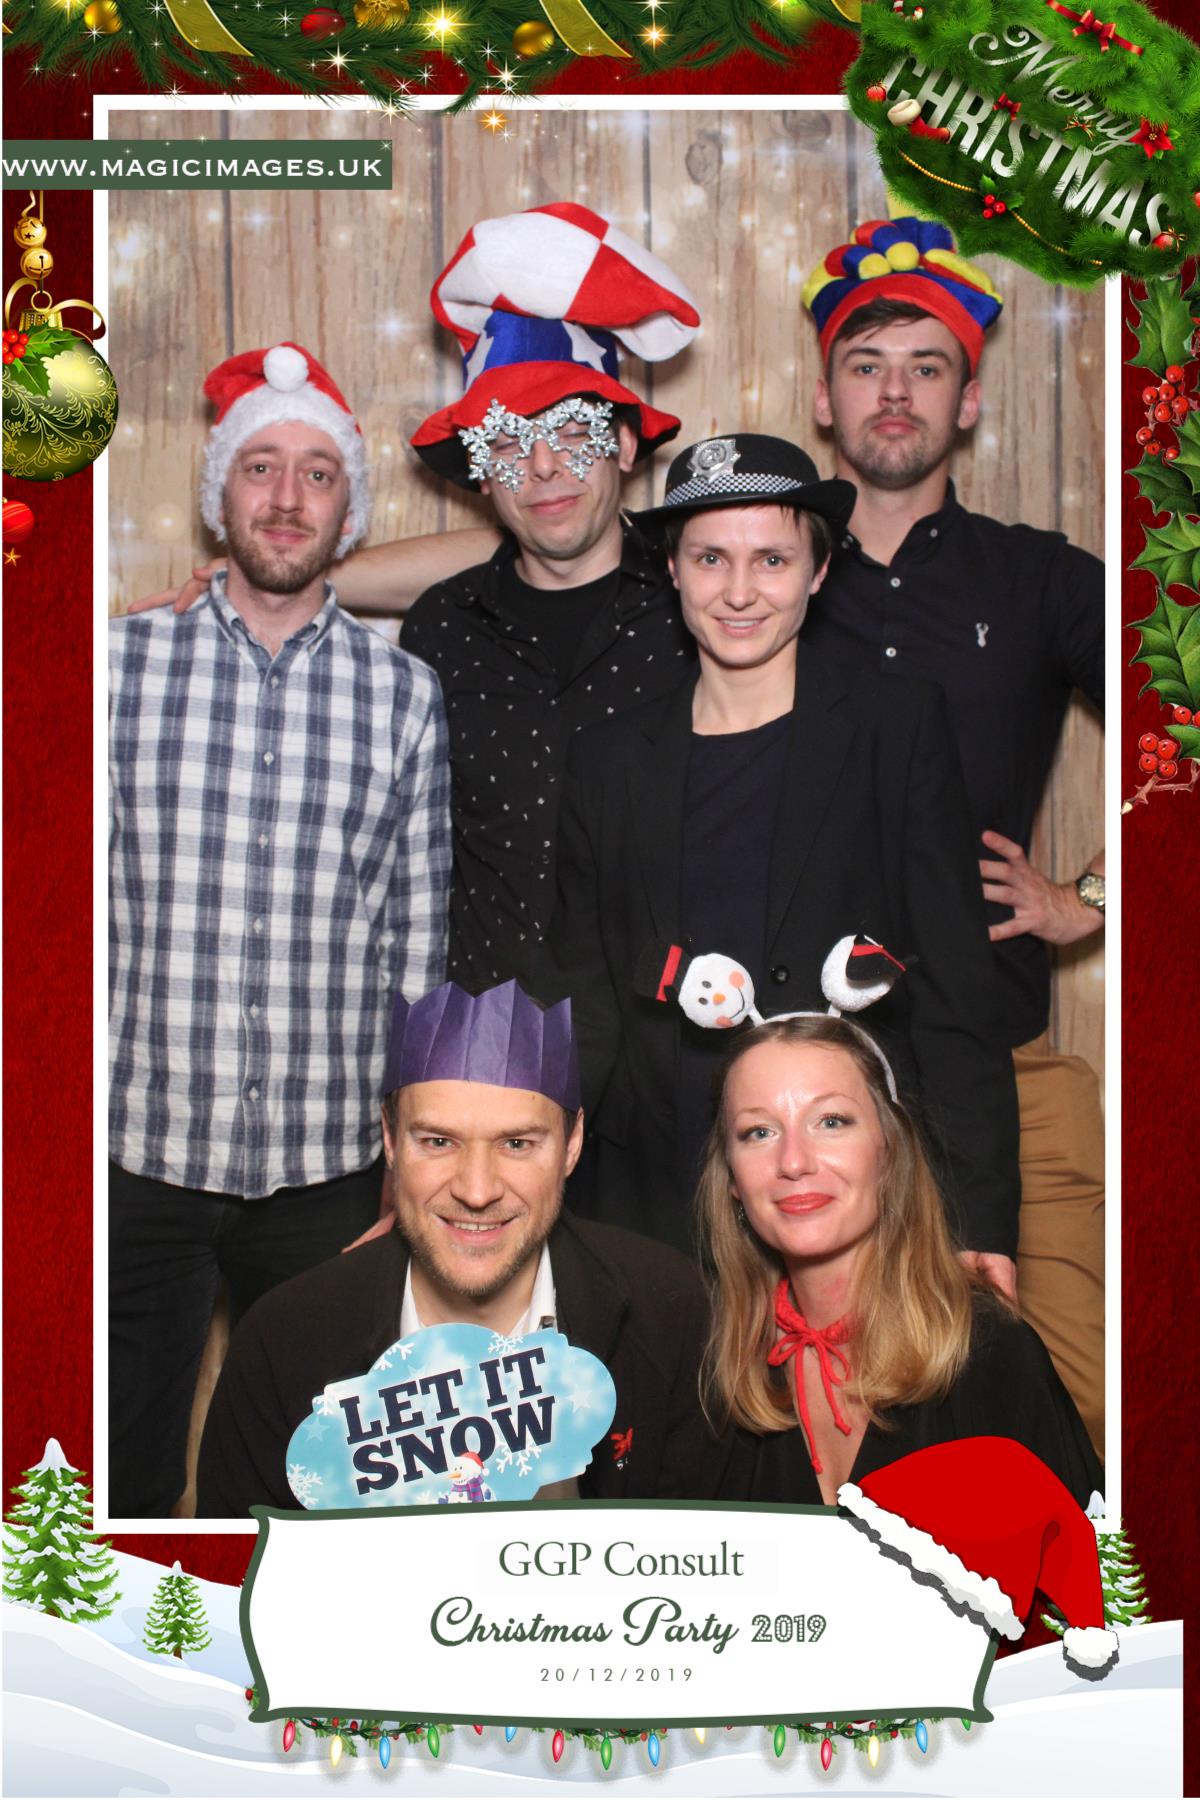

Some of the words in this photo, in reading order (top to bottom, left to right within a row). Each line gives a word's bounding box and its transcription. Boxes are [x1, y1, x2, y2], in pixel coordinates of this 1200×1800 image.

[339, 1368, 464, 1446] LET
[478, 1347, 546, 1408] IT
[352, 1395, 556, 1496] SNOW
